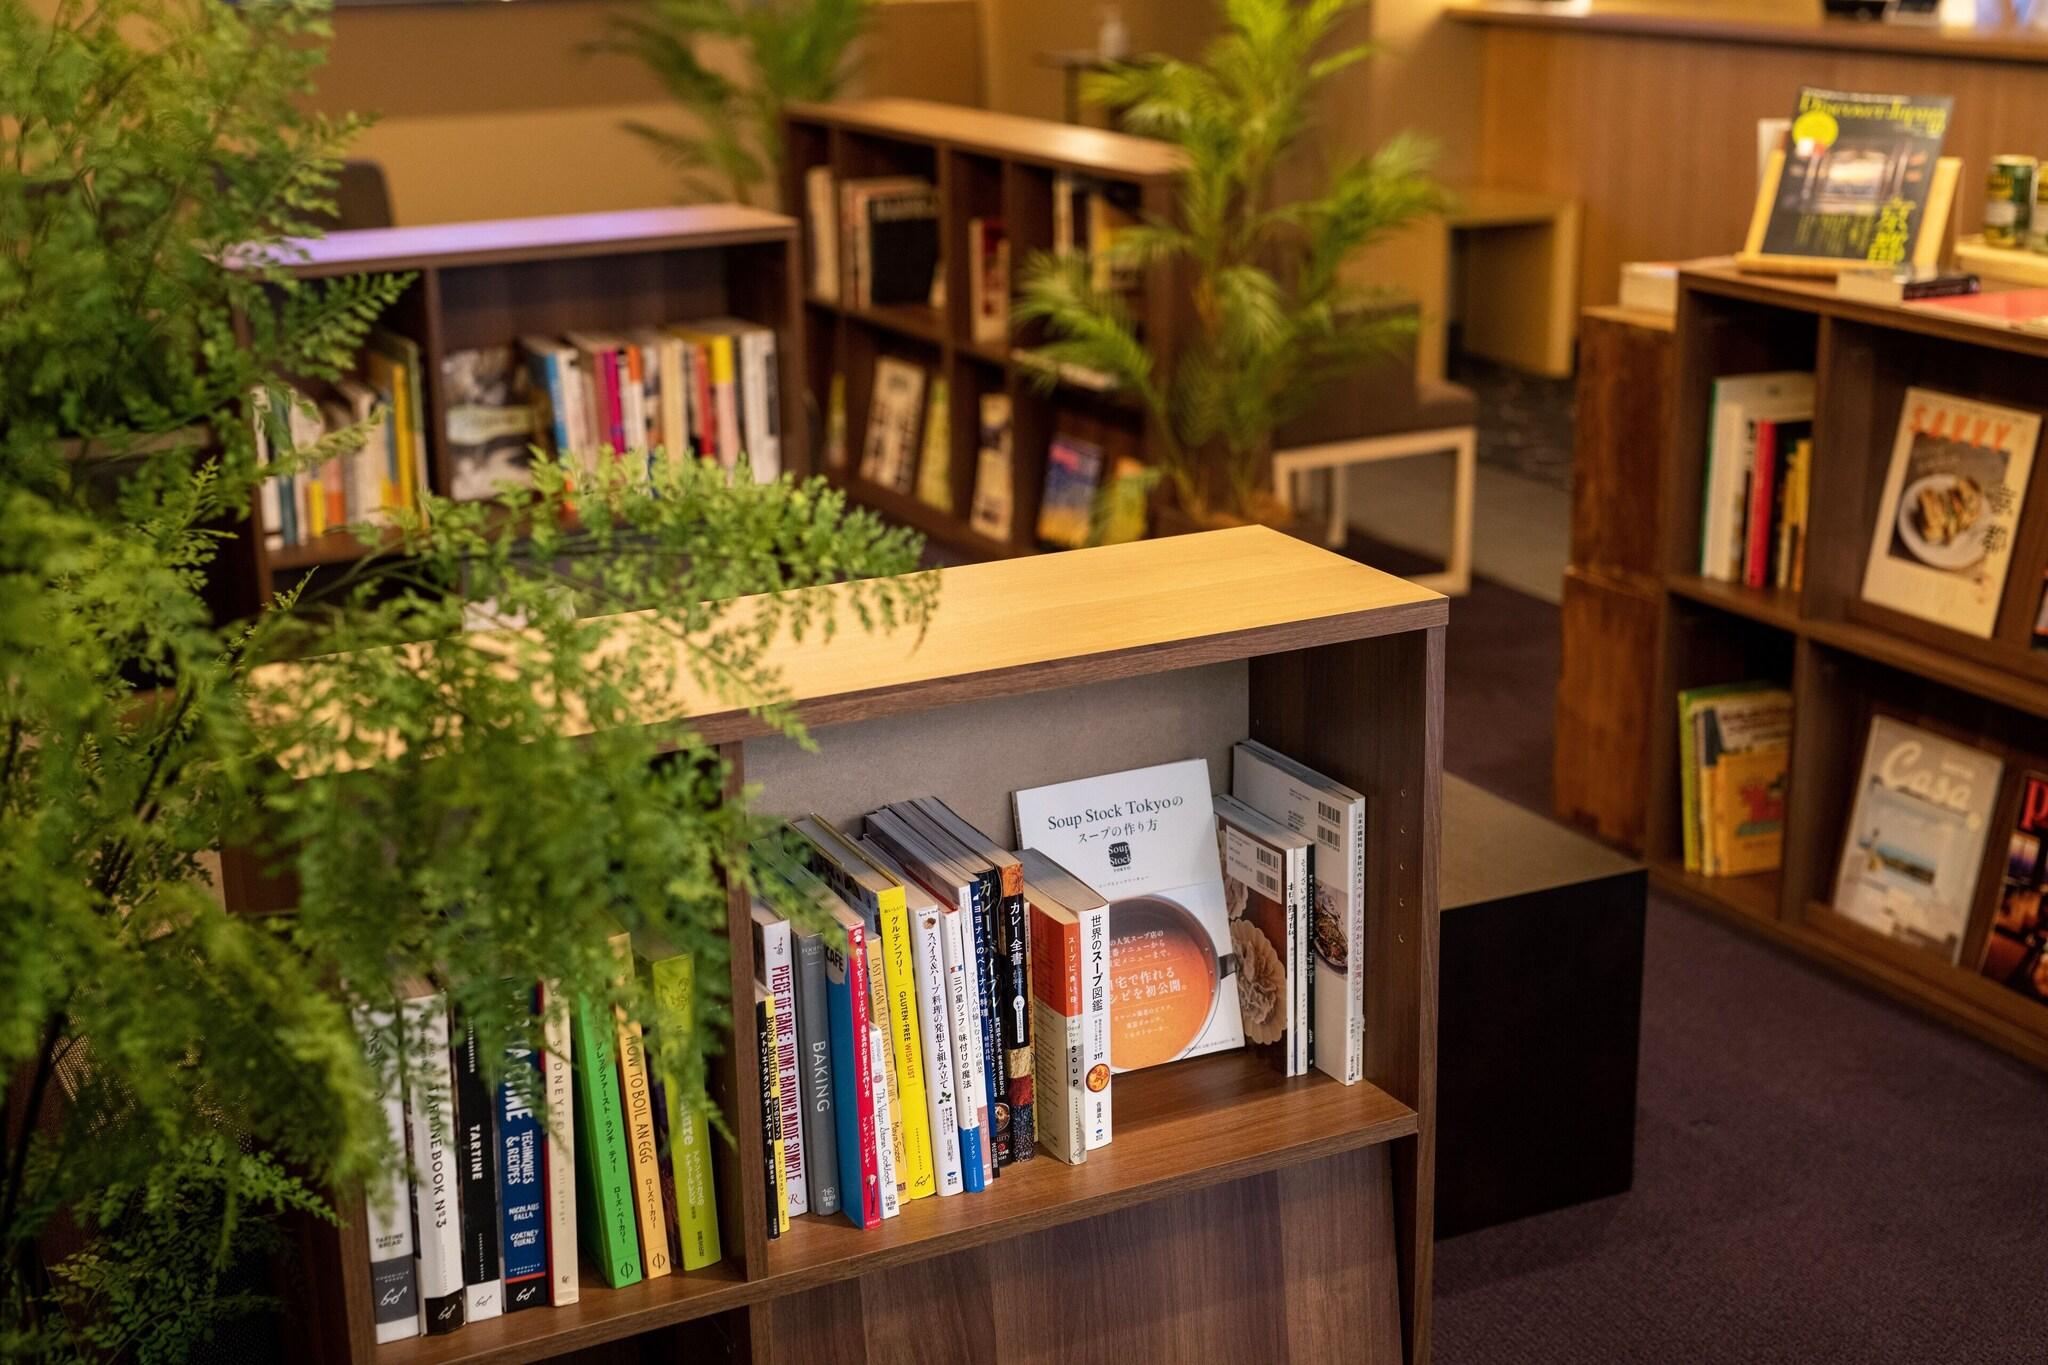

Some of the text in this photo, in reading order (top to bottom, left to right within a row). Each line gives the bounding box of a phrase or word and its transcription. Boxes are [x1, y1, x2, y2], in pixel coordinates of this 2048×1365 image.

[1879, 740, 1971, 812] Casa
[1047, 816, 1082, 830] Soup
[1085, 804, 1122, 823] Stock
[1078, 818, 1159, 844] スープの作り方
[1108, 844, 1130, 855] Soup
[1109, 855, 1132, 867] Stock
[891, 916, 903, 976] グルテンフリー
[973, 905, 988, 1017] ヨヨナムのベトナム料理
[1010, 902, 1024, 966] カレー全書
[1091, 915, 1103, 1013] 世界のスープ図鑑
[767, 1016, 777, 1087] Bob's Muffins
[899, 991, 915, 1079] GLUTEN-FREE WISH LIST
[1093, 1052, 1103, 1061] 317
[626, 1035, 653, 1164] HOW TO BOIL AN EGG
[760, 1031, 774, 1146] アトリエ・タタンのチーズケーキ
[772, 964, 802, 1183] PIECE OF CAKE: HOME BAKING MADE SIMPLE
[813, 1041, 830, 1113] BAKING
[876, 1089, 885, 1103] The
[428, 1085, 442, 1149] TARTINE
[877, 1105, 886, 1126] Vegan
[891, 1121, 900, 1139] Maya
[431, 1151, 445, 1196] BOOK
[469, 1124, 483, 1181] TARTINE
[506, 1136, 521, 1185] & RECIPES
[521, 1130, 534, 1184] TECHNIQUES
[510, 1229, 539, 1241] CORTNEY
